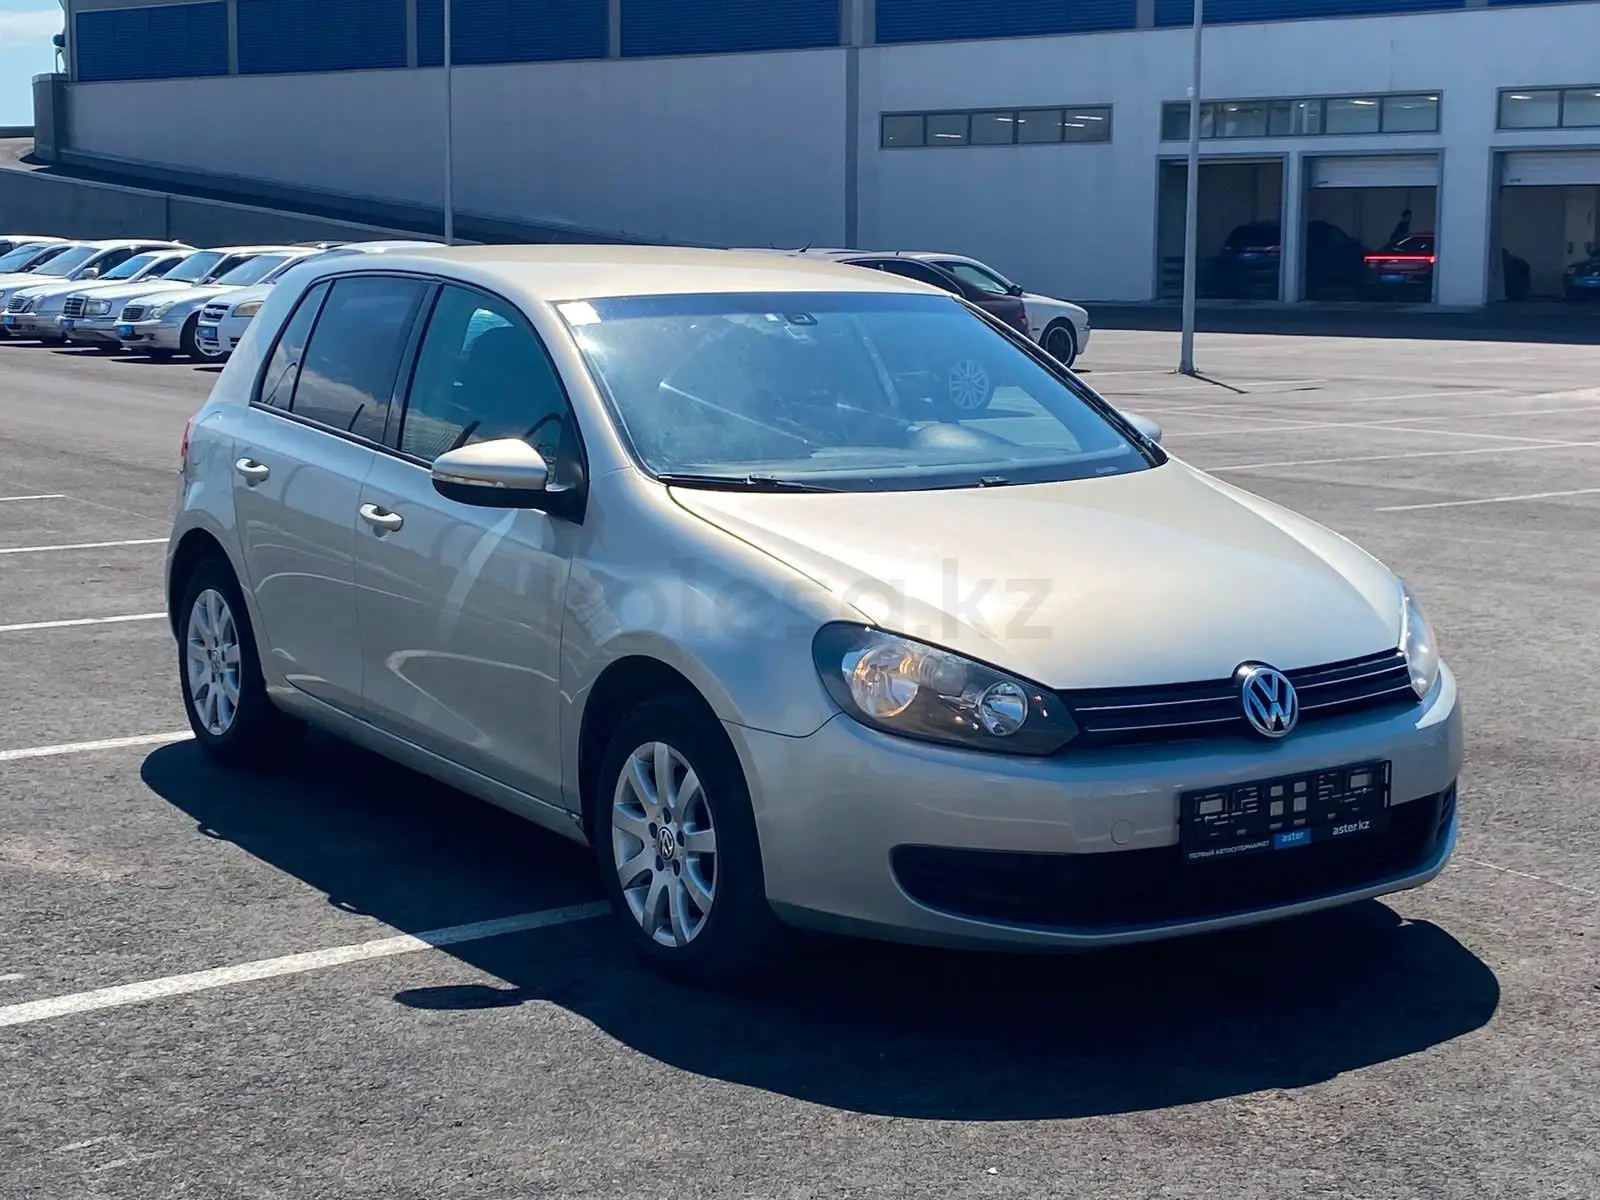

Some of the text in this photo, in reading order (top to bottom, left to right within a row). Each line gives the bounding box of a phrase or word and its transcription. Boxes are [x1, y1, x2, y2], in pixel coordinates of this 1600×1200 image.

[1243, 667, 1298, 737] VW
[1332, 820, 1371, 836] aster.kz
[1281, 831, 1305, 843] aster
